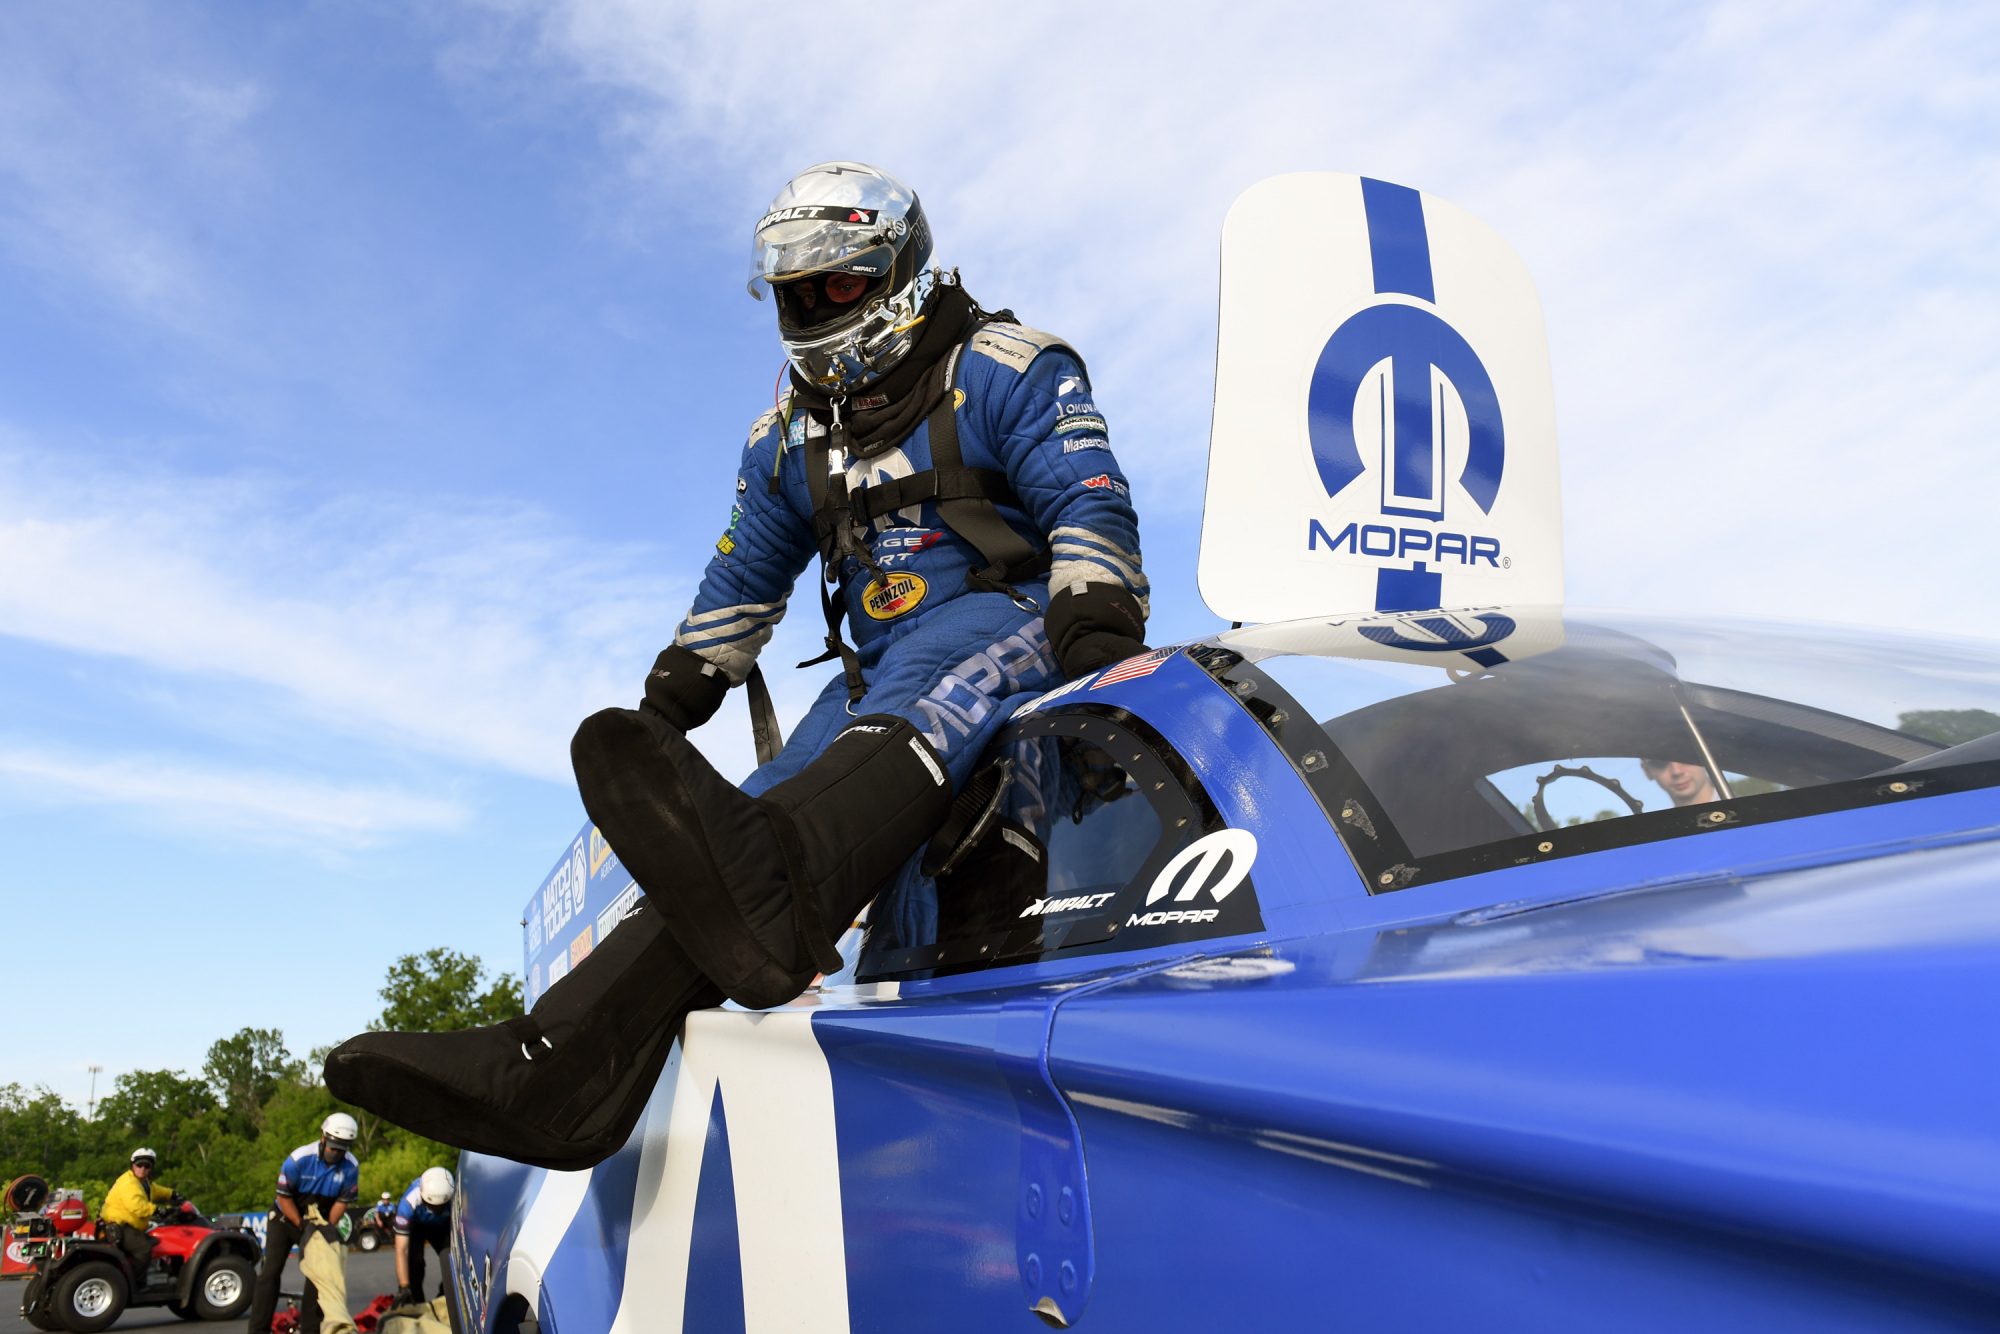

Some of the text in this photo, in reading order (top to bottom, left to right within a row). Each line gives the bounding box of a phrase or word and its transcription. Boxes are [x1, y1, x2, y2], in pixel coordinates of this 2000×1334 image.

[852, 265, 878, 273] IMPACT
[990, 343, 1026, 360] IMPACT
[1308, 518, 1501, 568] MOPAR
[868, 578, 917, 613] PENNZOIL
[543, 858, 571, 918] MATCO
[544, 892, 572, 945] TOOLS
[1125, 909, 1220, 928] MOPAR
